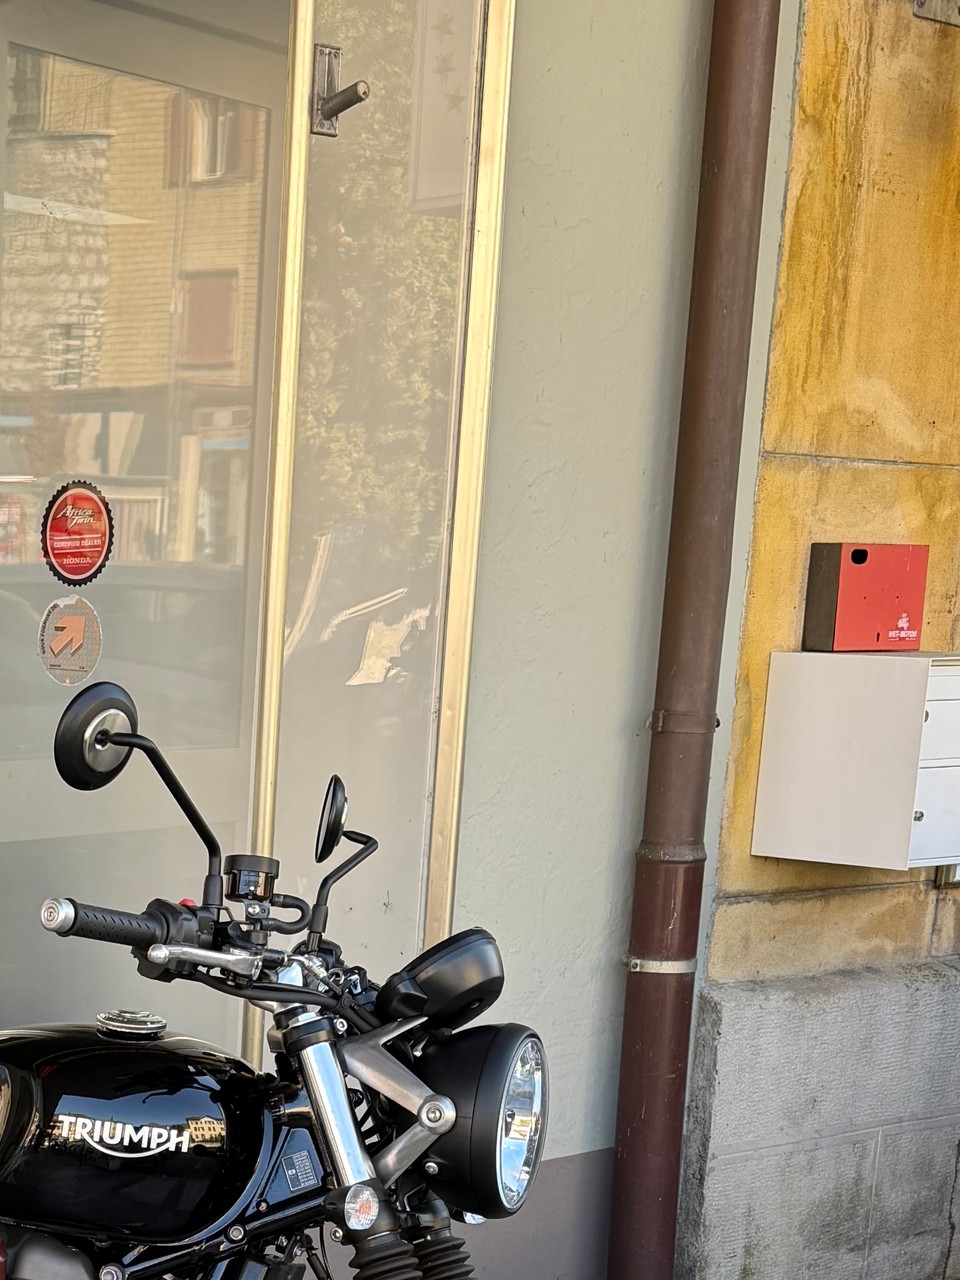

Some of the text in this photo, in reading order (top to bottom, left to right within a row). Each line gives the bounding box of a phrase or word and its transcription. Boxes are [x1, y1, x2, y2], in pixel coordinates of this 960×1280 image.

[56, 505, 94, 519] Africa
[67, 516, 96, 530] Twin
[63, 557, 92, 565] HONDA
[58, 1115, 189, 1156] TRIUMPH
